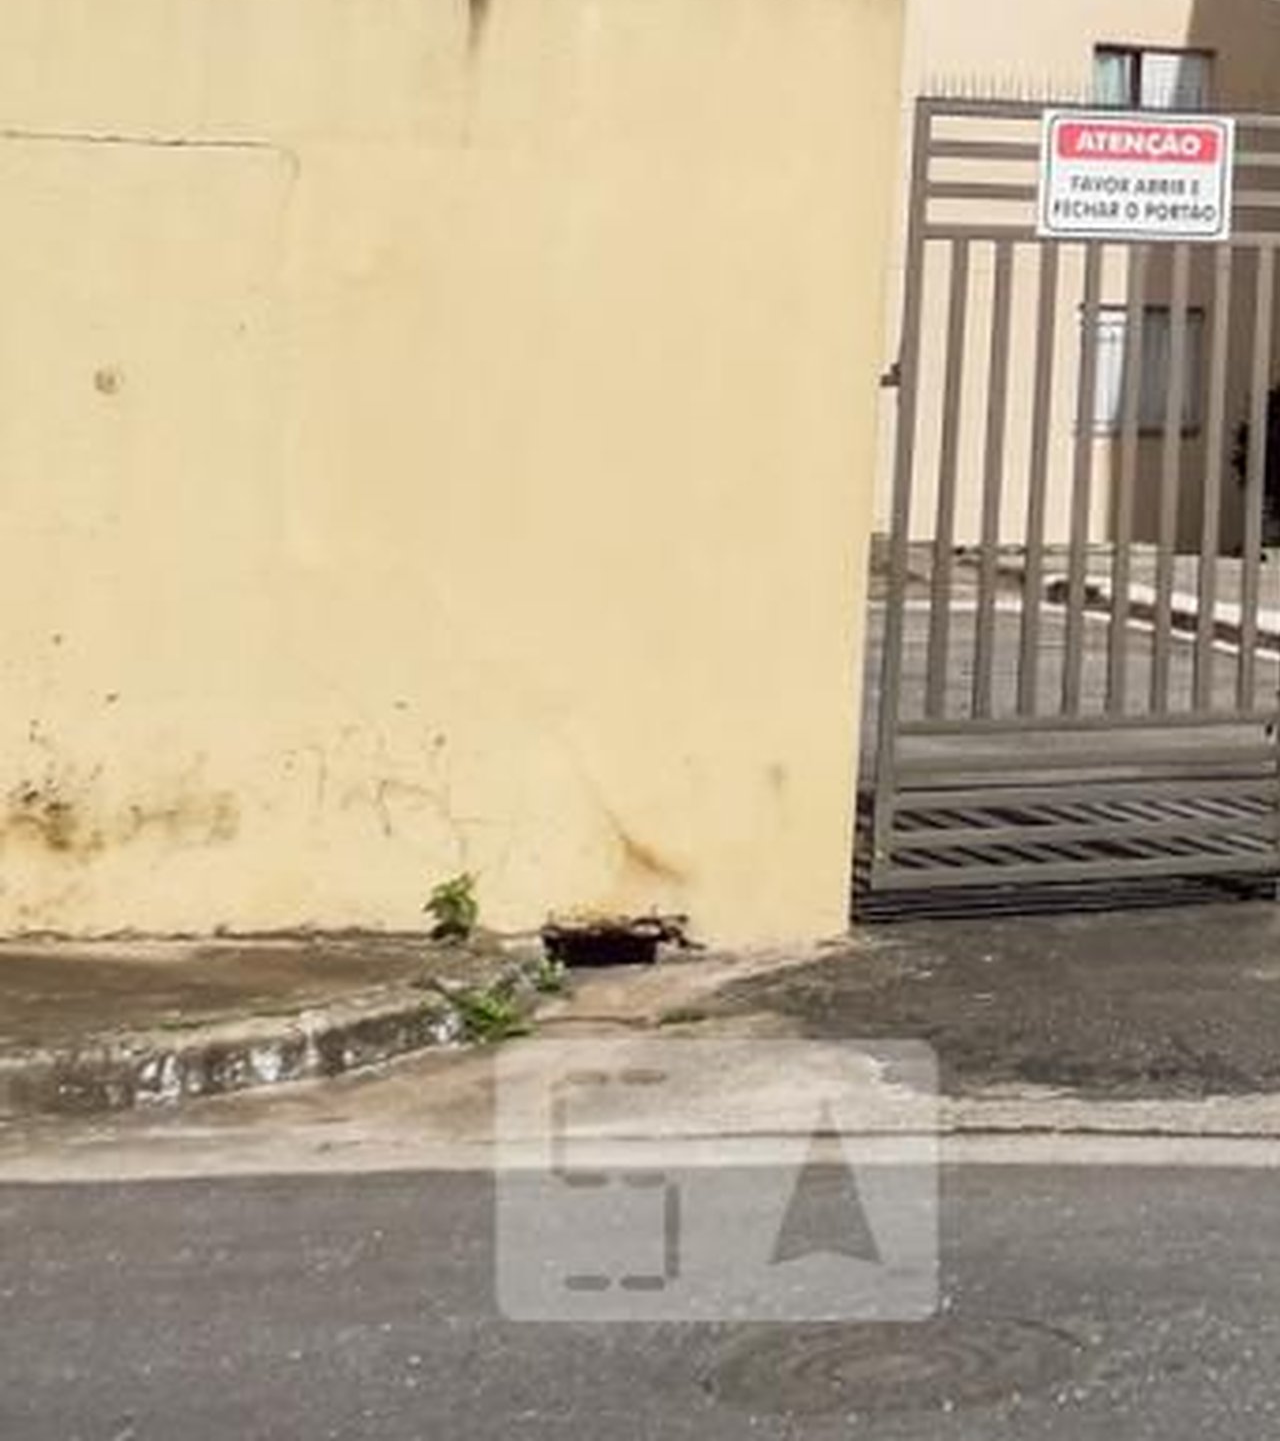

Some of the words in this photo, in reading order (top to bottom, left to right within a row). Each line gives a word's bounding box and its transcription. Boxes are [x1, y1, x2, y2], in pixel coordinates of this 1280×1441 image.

[1069, 175, 1130, 195] FAVOR
[1134, 178, 1186, 196] ABRIR
[1190, 179, 1200, 196] E
[1053, 197, 1120, 219] FECHAR
[1125, 202, 1139, 220] O
